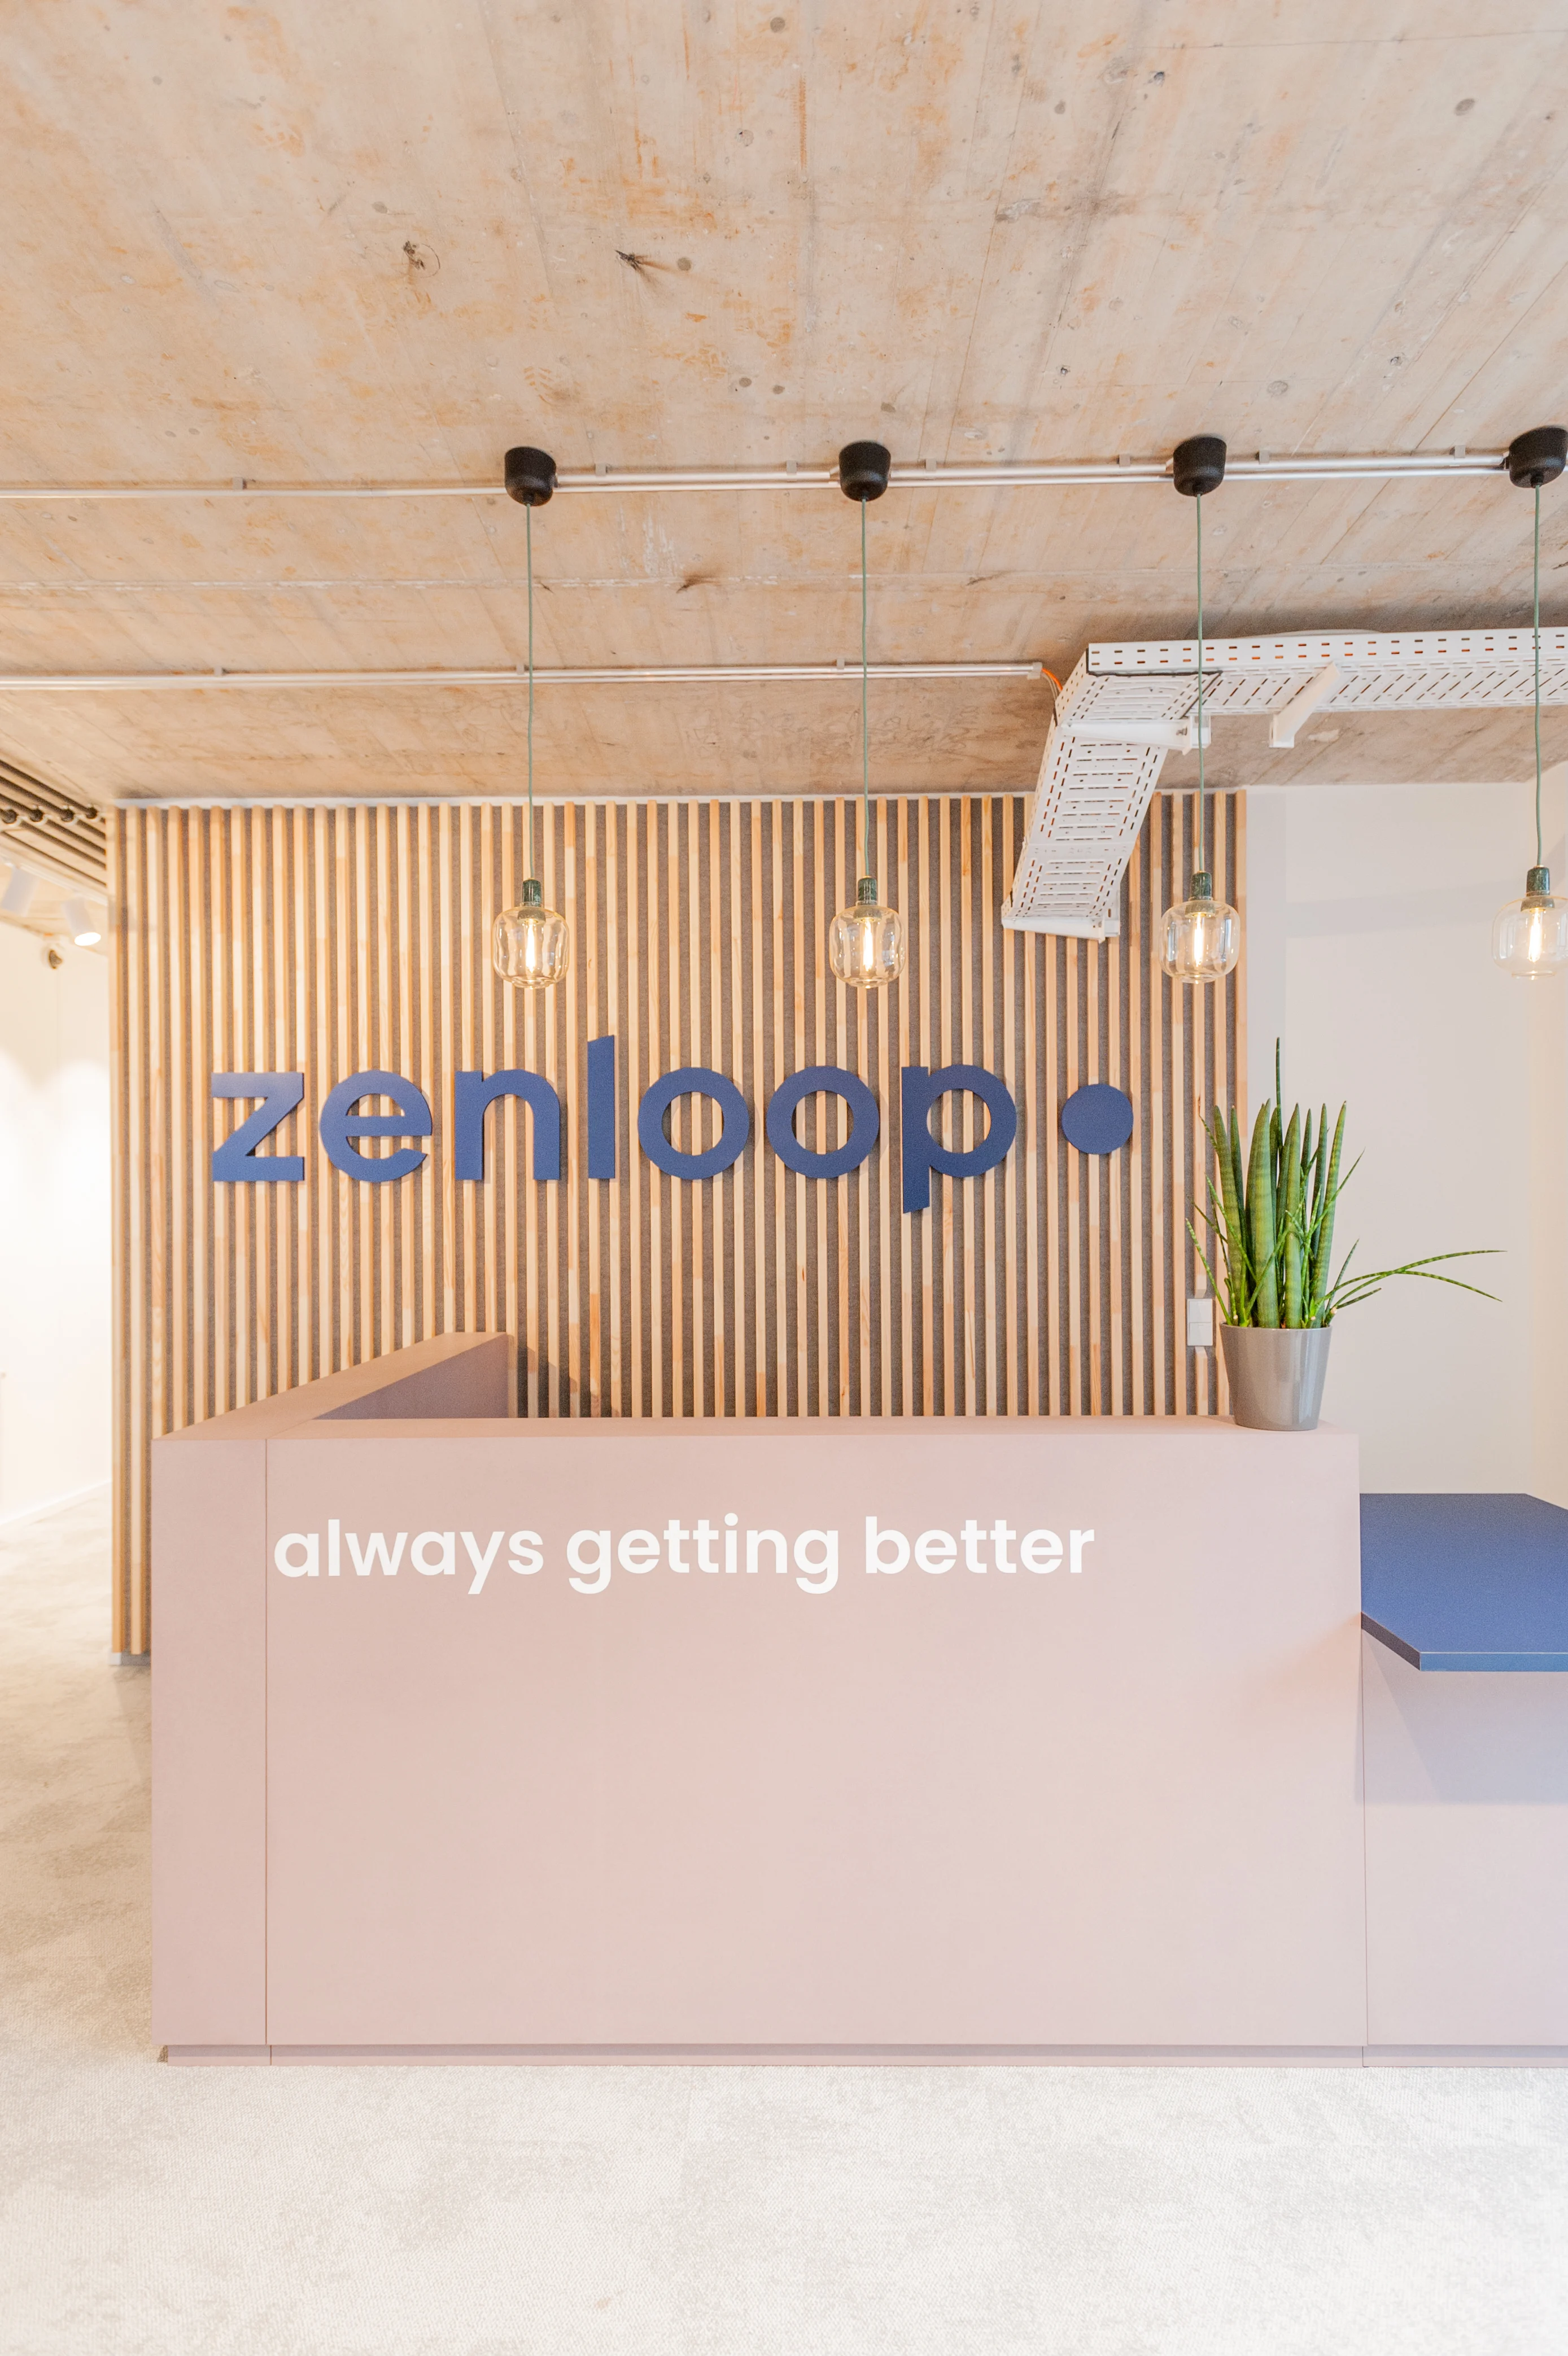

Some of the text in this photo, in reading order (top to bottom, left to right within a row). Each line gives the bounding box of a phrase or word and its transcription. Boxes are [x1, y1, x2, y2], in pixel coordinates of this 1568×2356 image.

[211, 1034, 1017, 1213] zenloop
[274, 1513, 1095, 1594] always getting better
